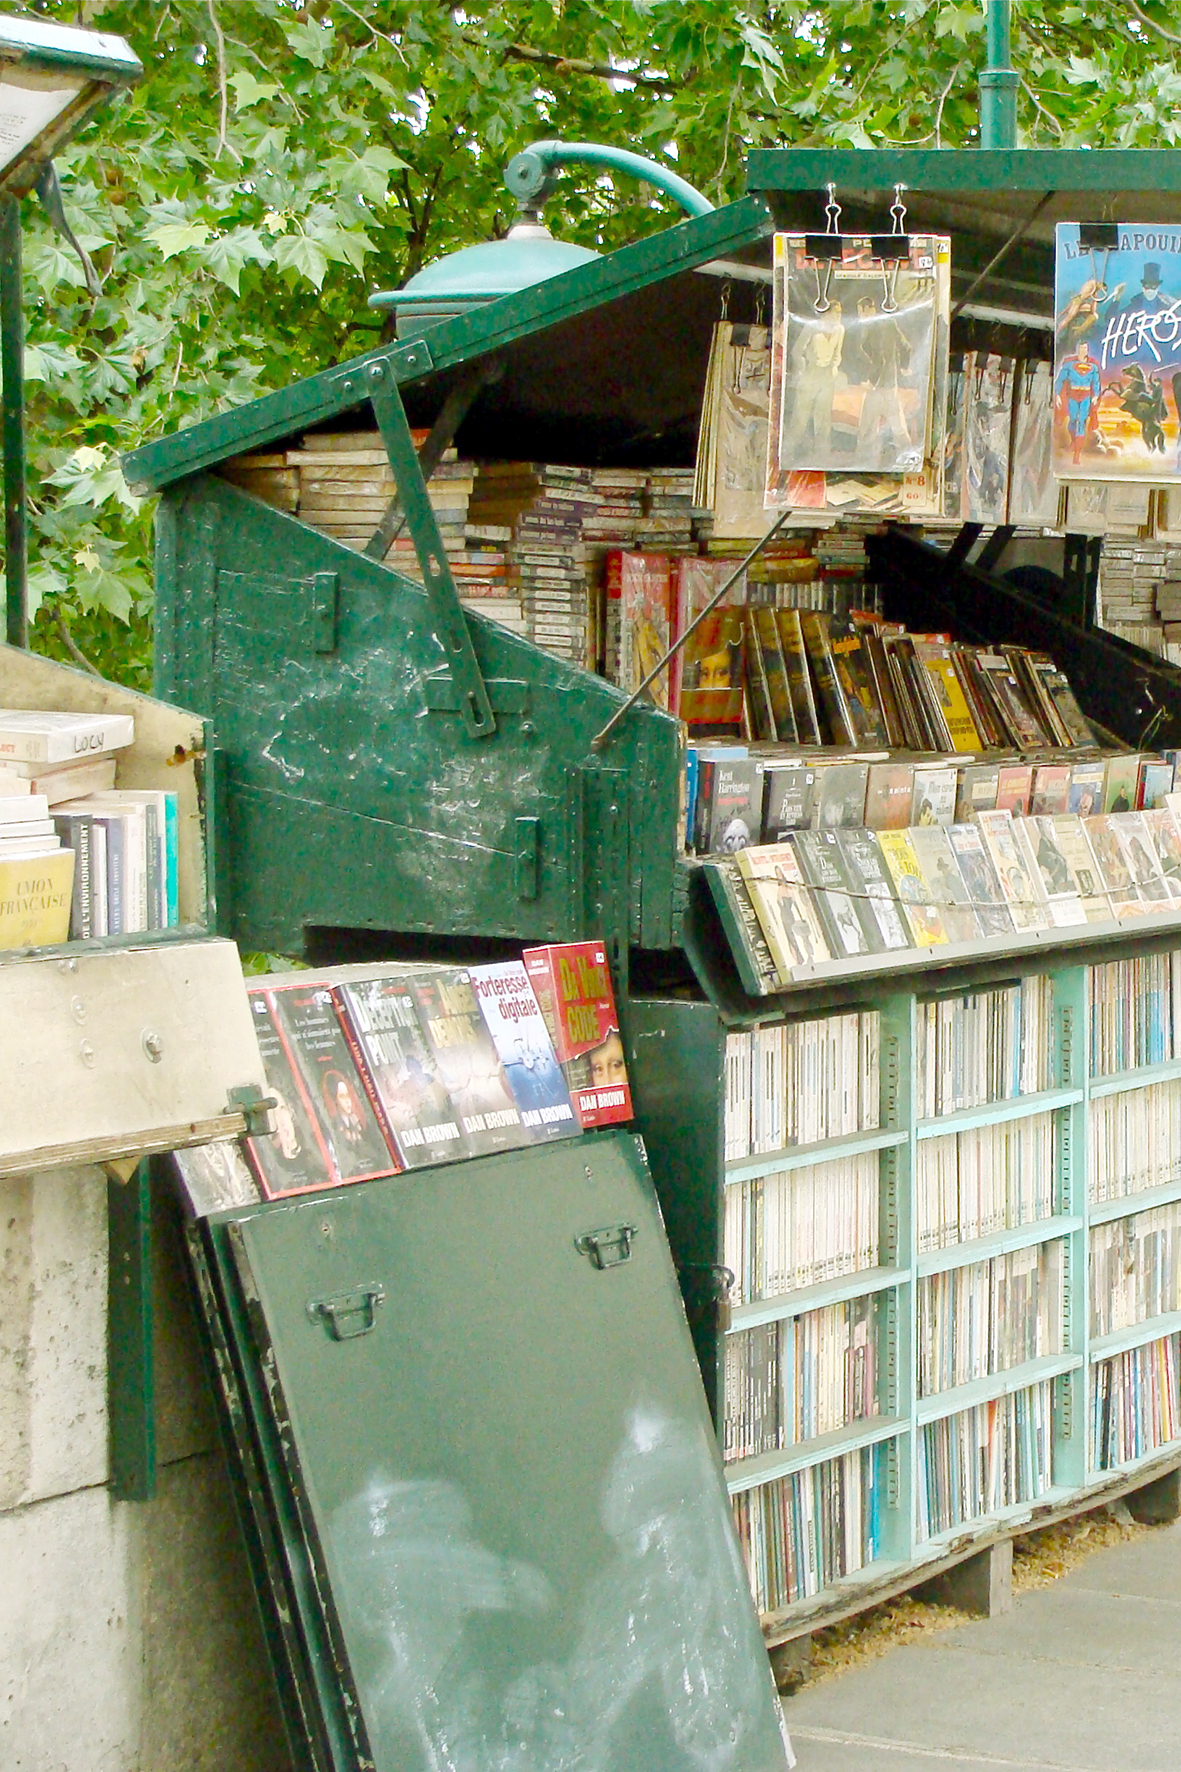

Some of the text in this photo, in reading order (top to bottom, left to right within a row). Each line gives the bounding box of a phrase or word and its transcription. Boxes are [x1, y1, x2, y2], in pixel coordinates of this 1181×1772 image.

[17, 878, 53, 896] UNION
[80, 824, 91, 940] DE L'ENVIRONNEMENT
[473, 975, 528, 999] Forteresse
[498, 996, 538, 1023] digitale
[566, 1004, 601, 1044] CODE
[580, 1090, 626, 1111] DAN BROWN
[463, 1108, 520, 1134] DAN BROWN
[521, 1104, 573, 1128] DAN BROWN
[401, 1122, 461, 1148] DAN BROWN
